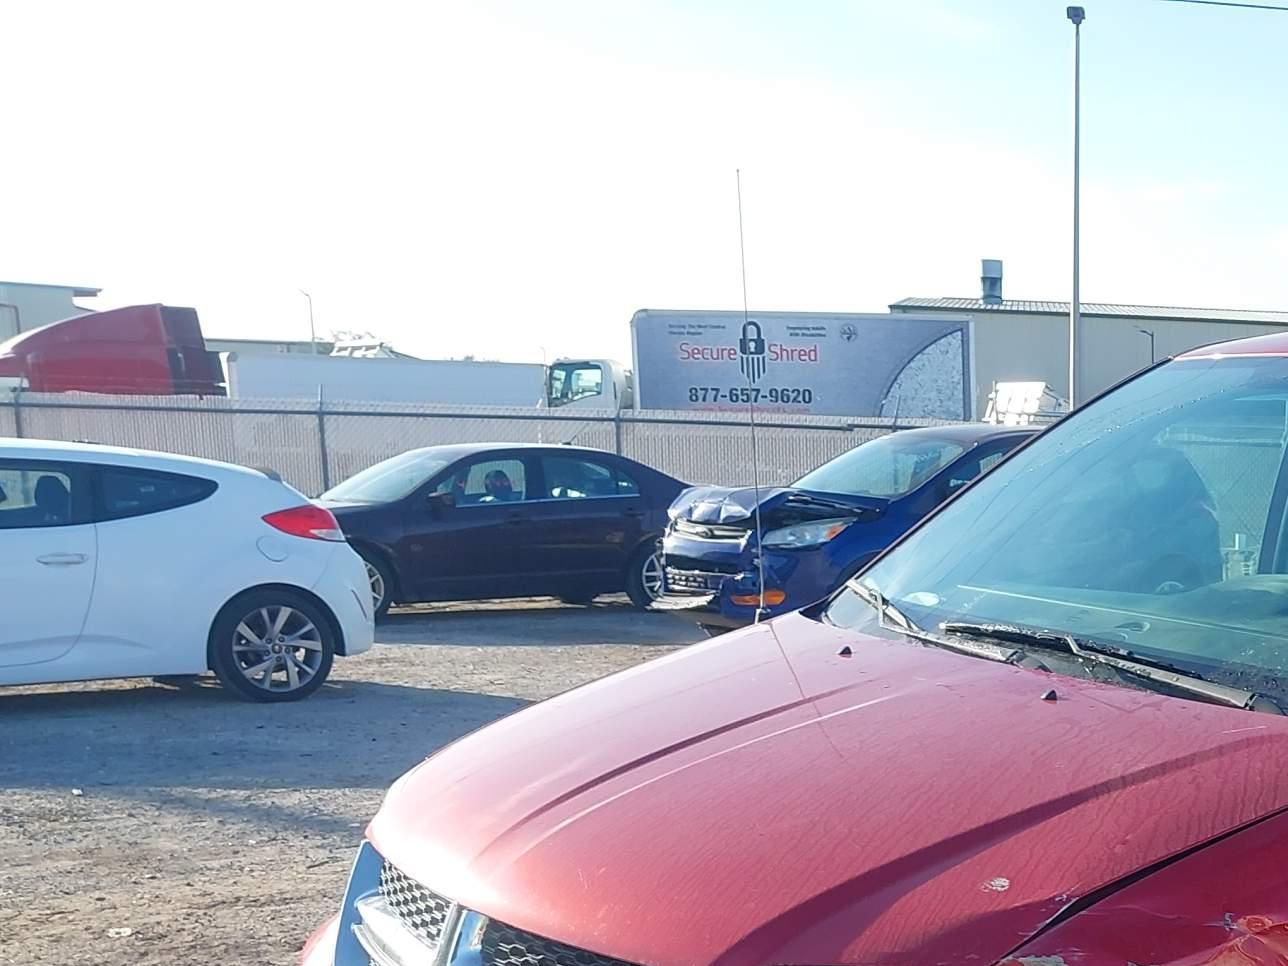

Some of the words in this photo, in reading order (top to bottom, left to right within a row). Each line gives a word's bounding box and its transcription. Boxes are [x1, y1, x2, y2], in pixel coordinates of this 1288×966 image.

[679, 342, 738, 361] Secure
[767, 343, 818, 362] Shred
[688, 386, 813, 404] 877-657-9620
